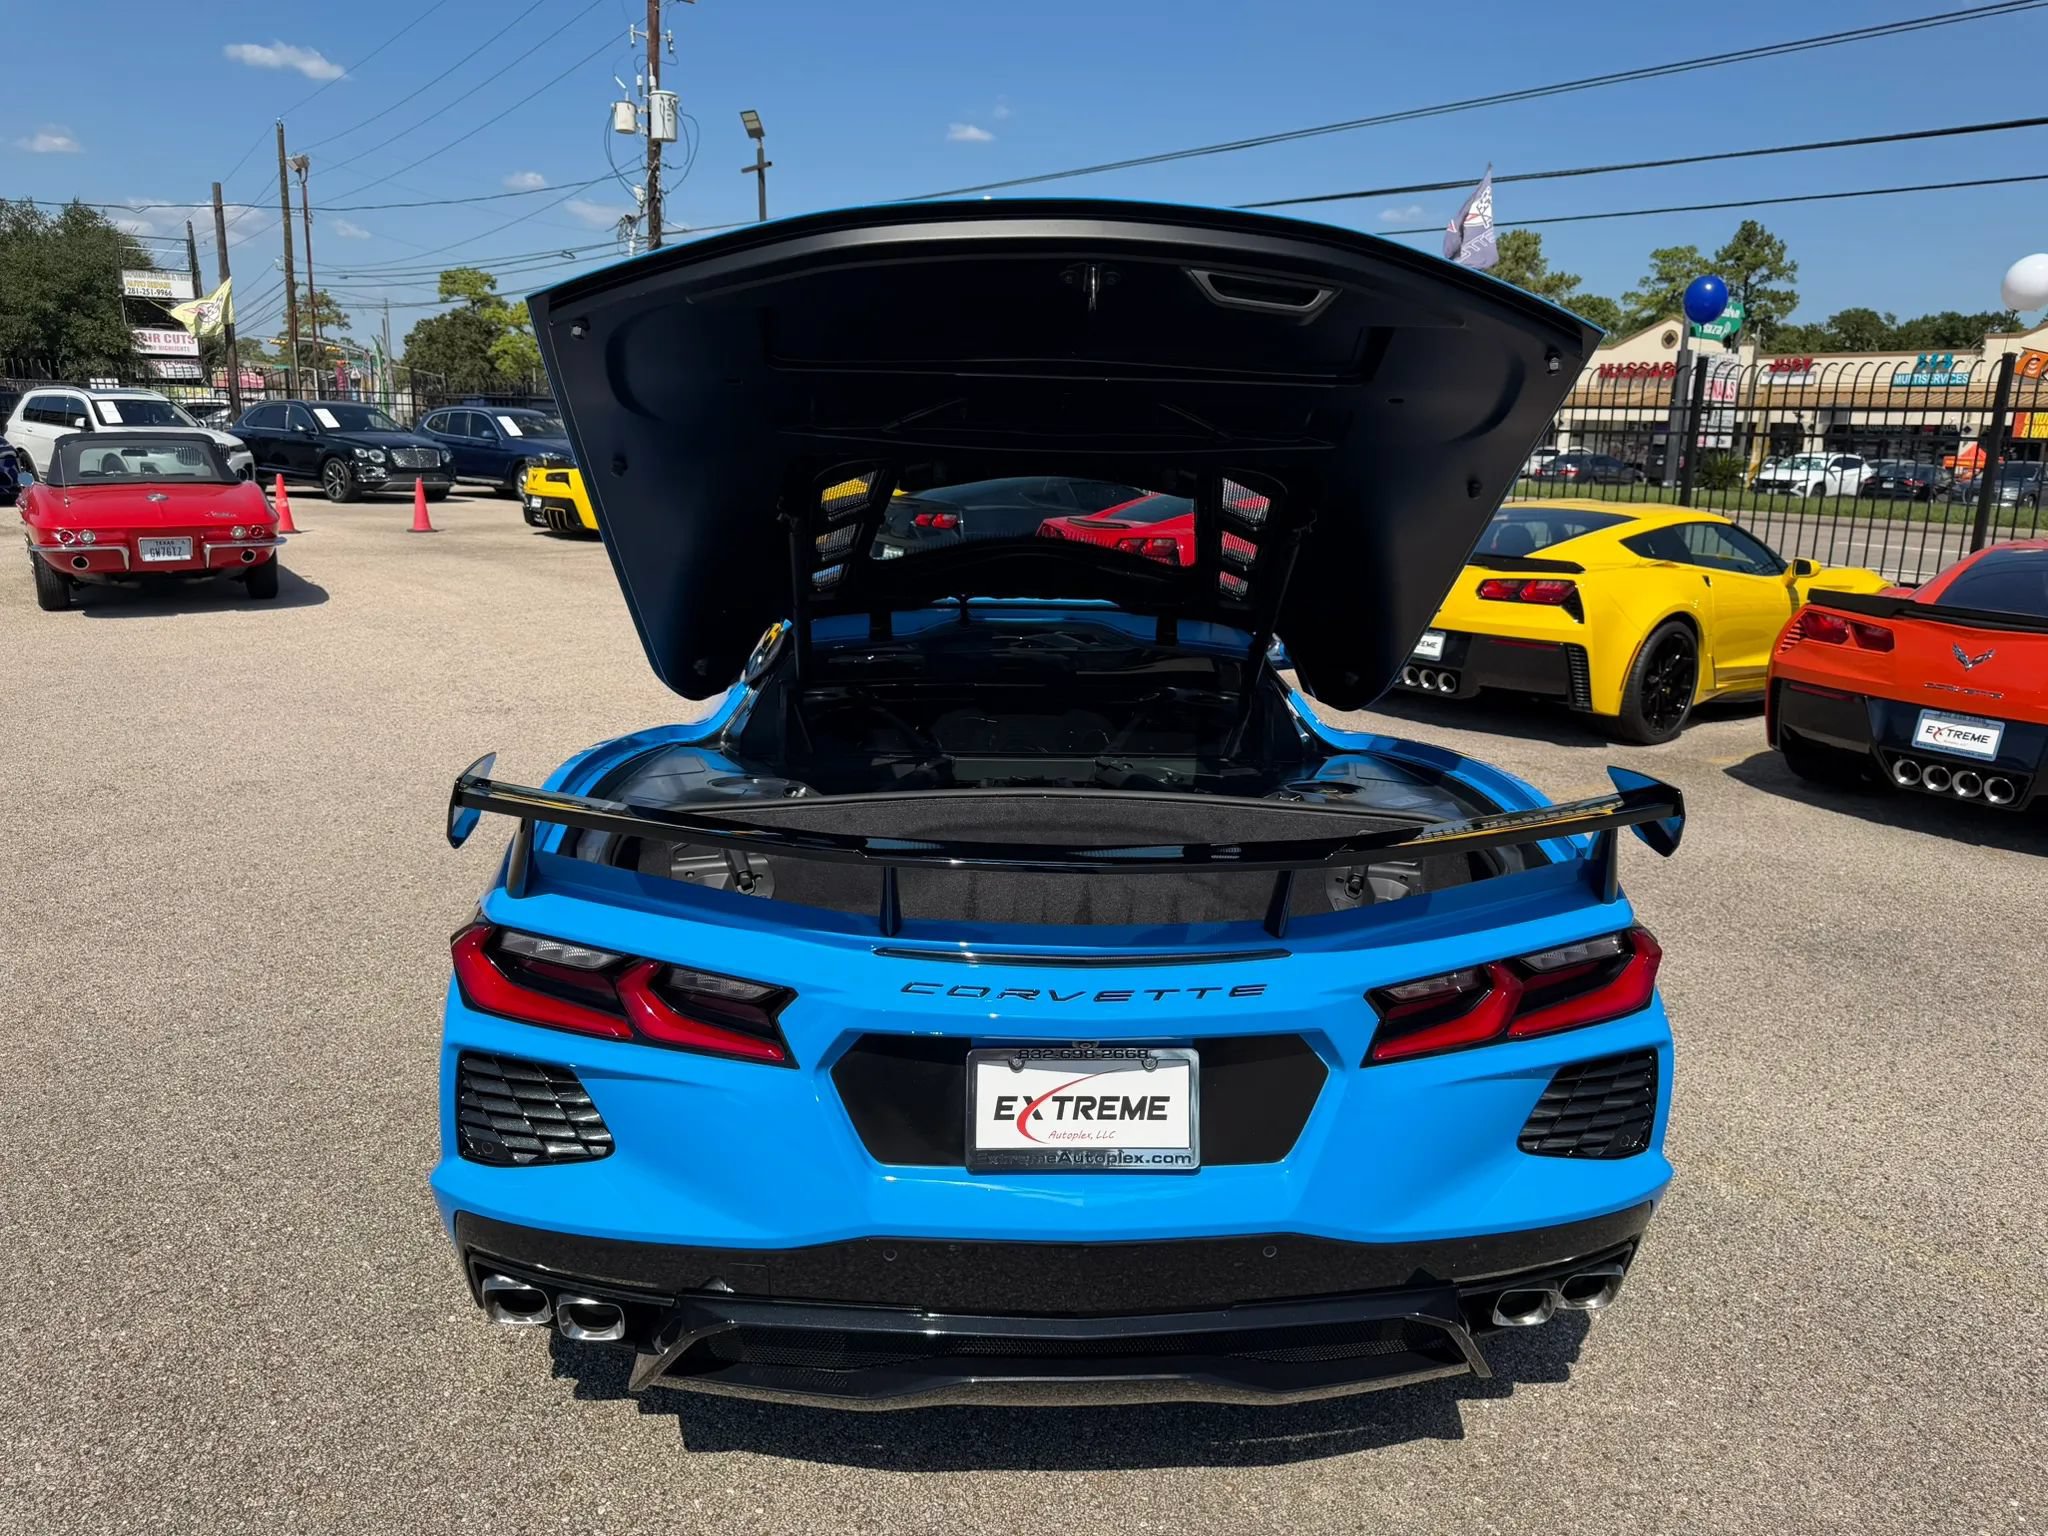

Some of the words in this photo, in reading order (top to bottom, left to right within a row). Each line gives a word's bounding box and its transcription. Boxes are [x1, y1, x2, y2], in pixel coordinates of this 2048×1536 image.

[128, 288, 173, 297] 281-251-9966
[164, 333, 195, 345] CUTS
[1599, 361, 1678, 379] MASSAG
[1925, 725, 1990, 744] EXTREME
[900, 981, 1268, 1002] CORVETTE
[1018, 1049, 1149, 1061] 832-698-2668
[993, 1095, 1171, 1121] EXTREME
[1048, 1130, 1094, 1141] Autoplex,
[1096, 1130, 1116, 1140] LLC
